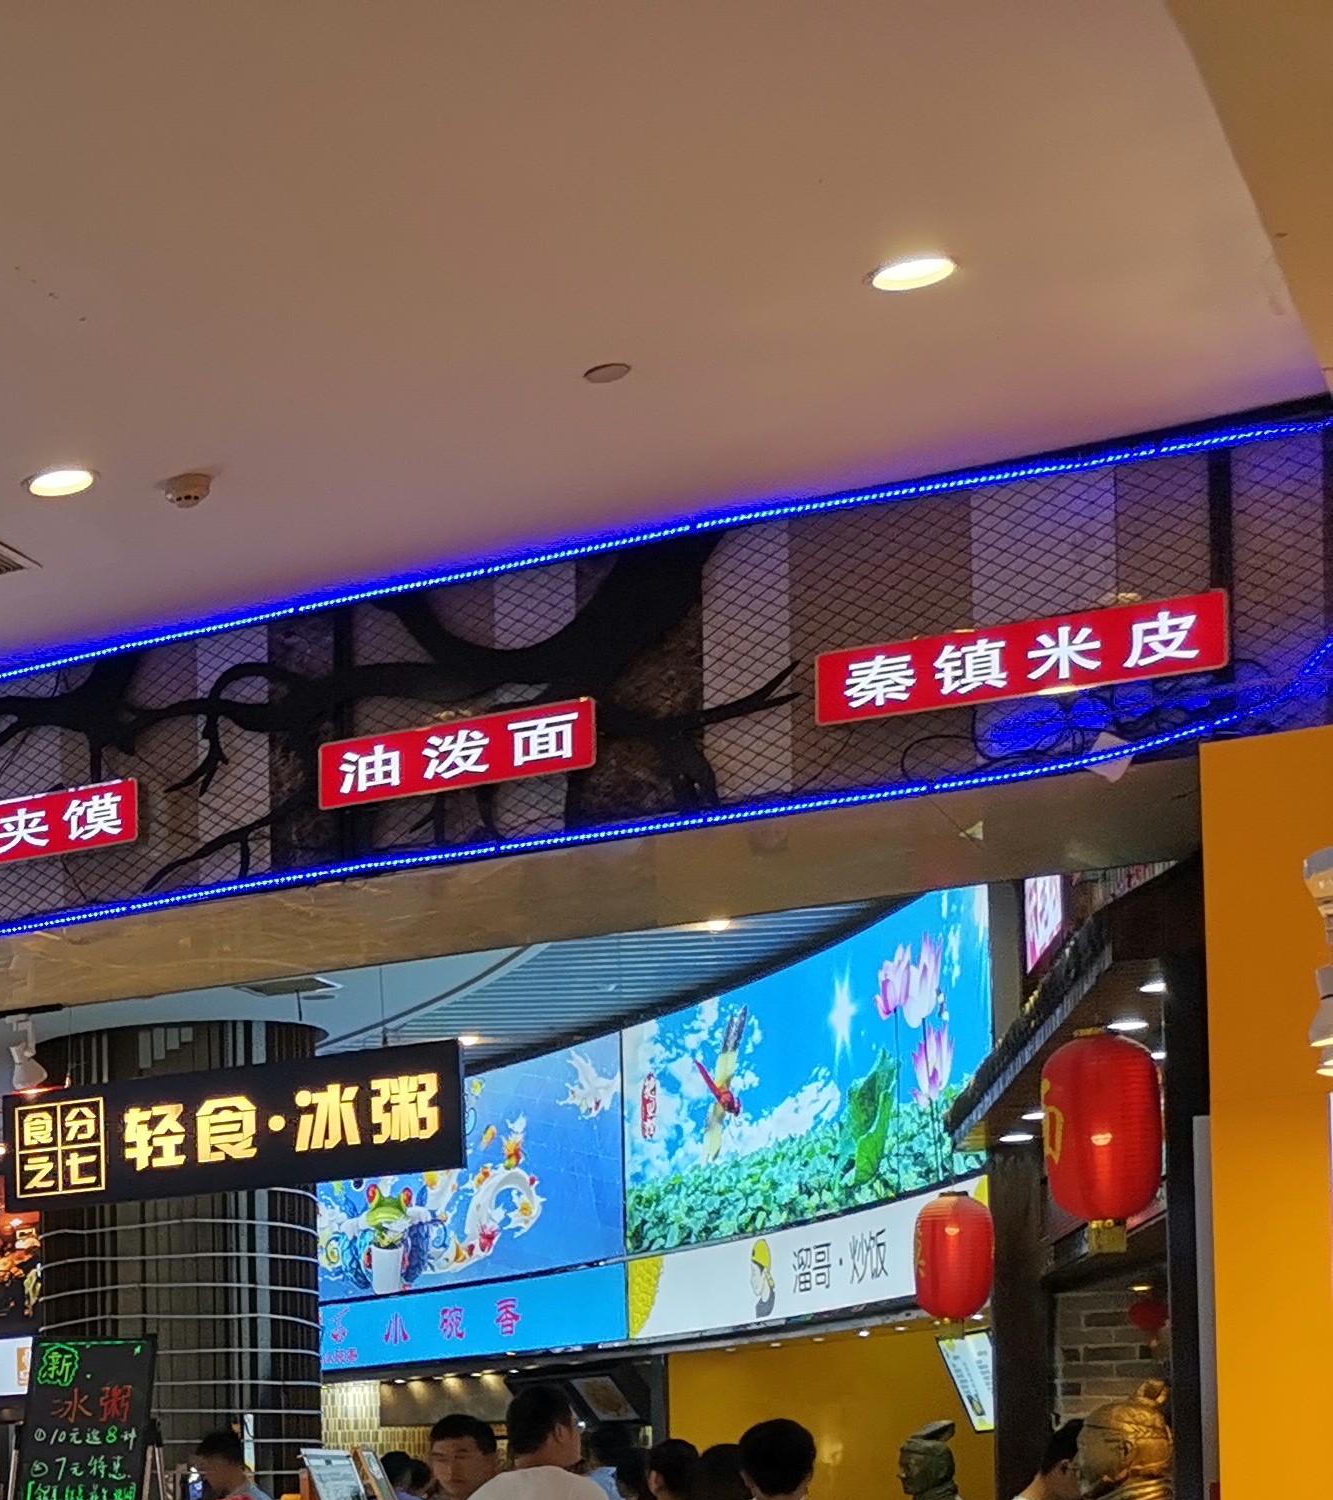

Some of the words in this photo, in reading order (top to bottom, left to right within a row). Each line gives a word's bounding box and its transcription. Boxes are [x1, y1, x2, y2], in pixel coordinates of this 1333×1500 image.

[843, 611, 1200, 708] 秦镇米皮
[337, 711, 578, 795] 油泼面
[384, 1298, 521, 1345] 小碗香
[42, 1352, 73, 1382] 新
[51, 1384, 132, 1424] 冰粥
